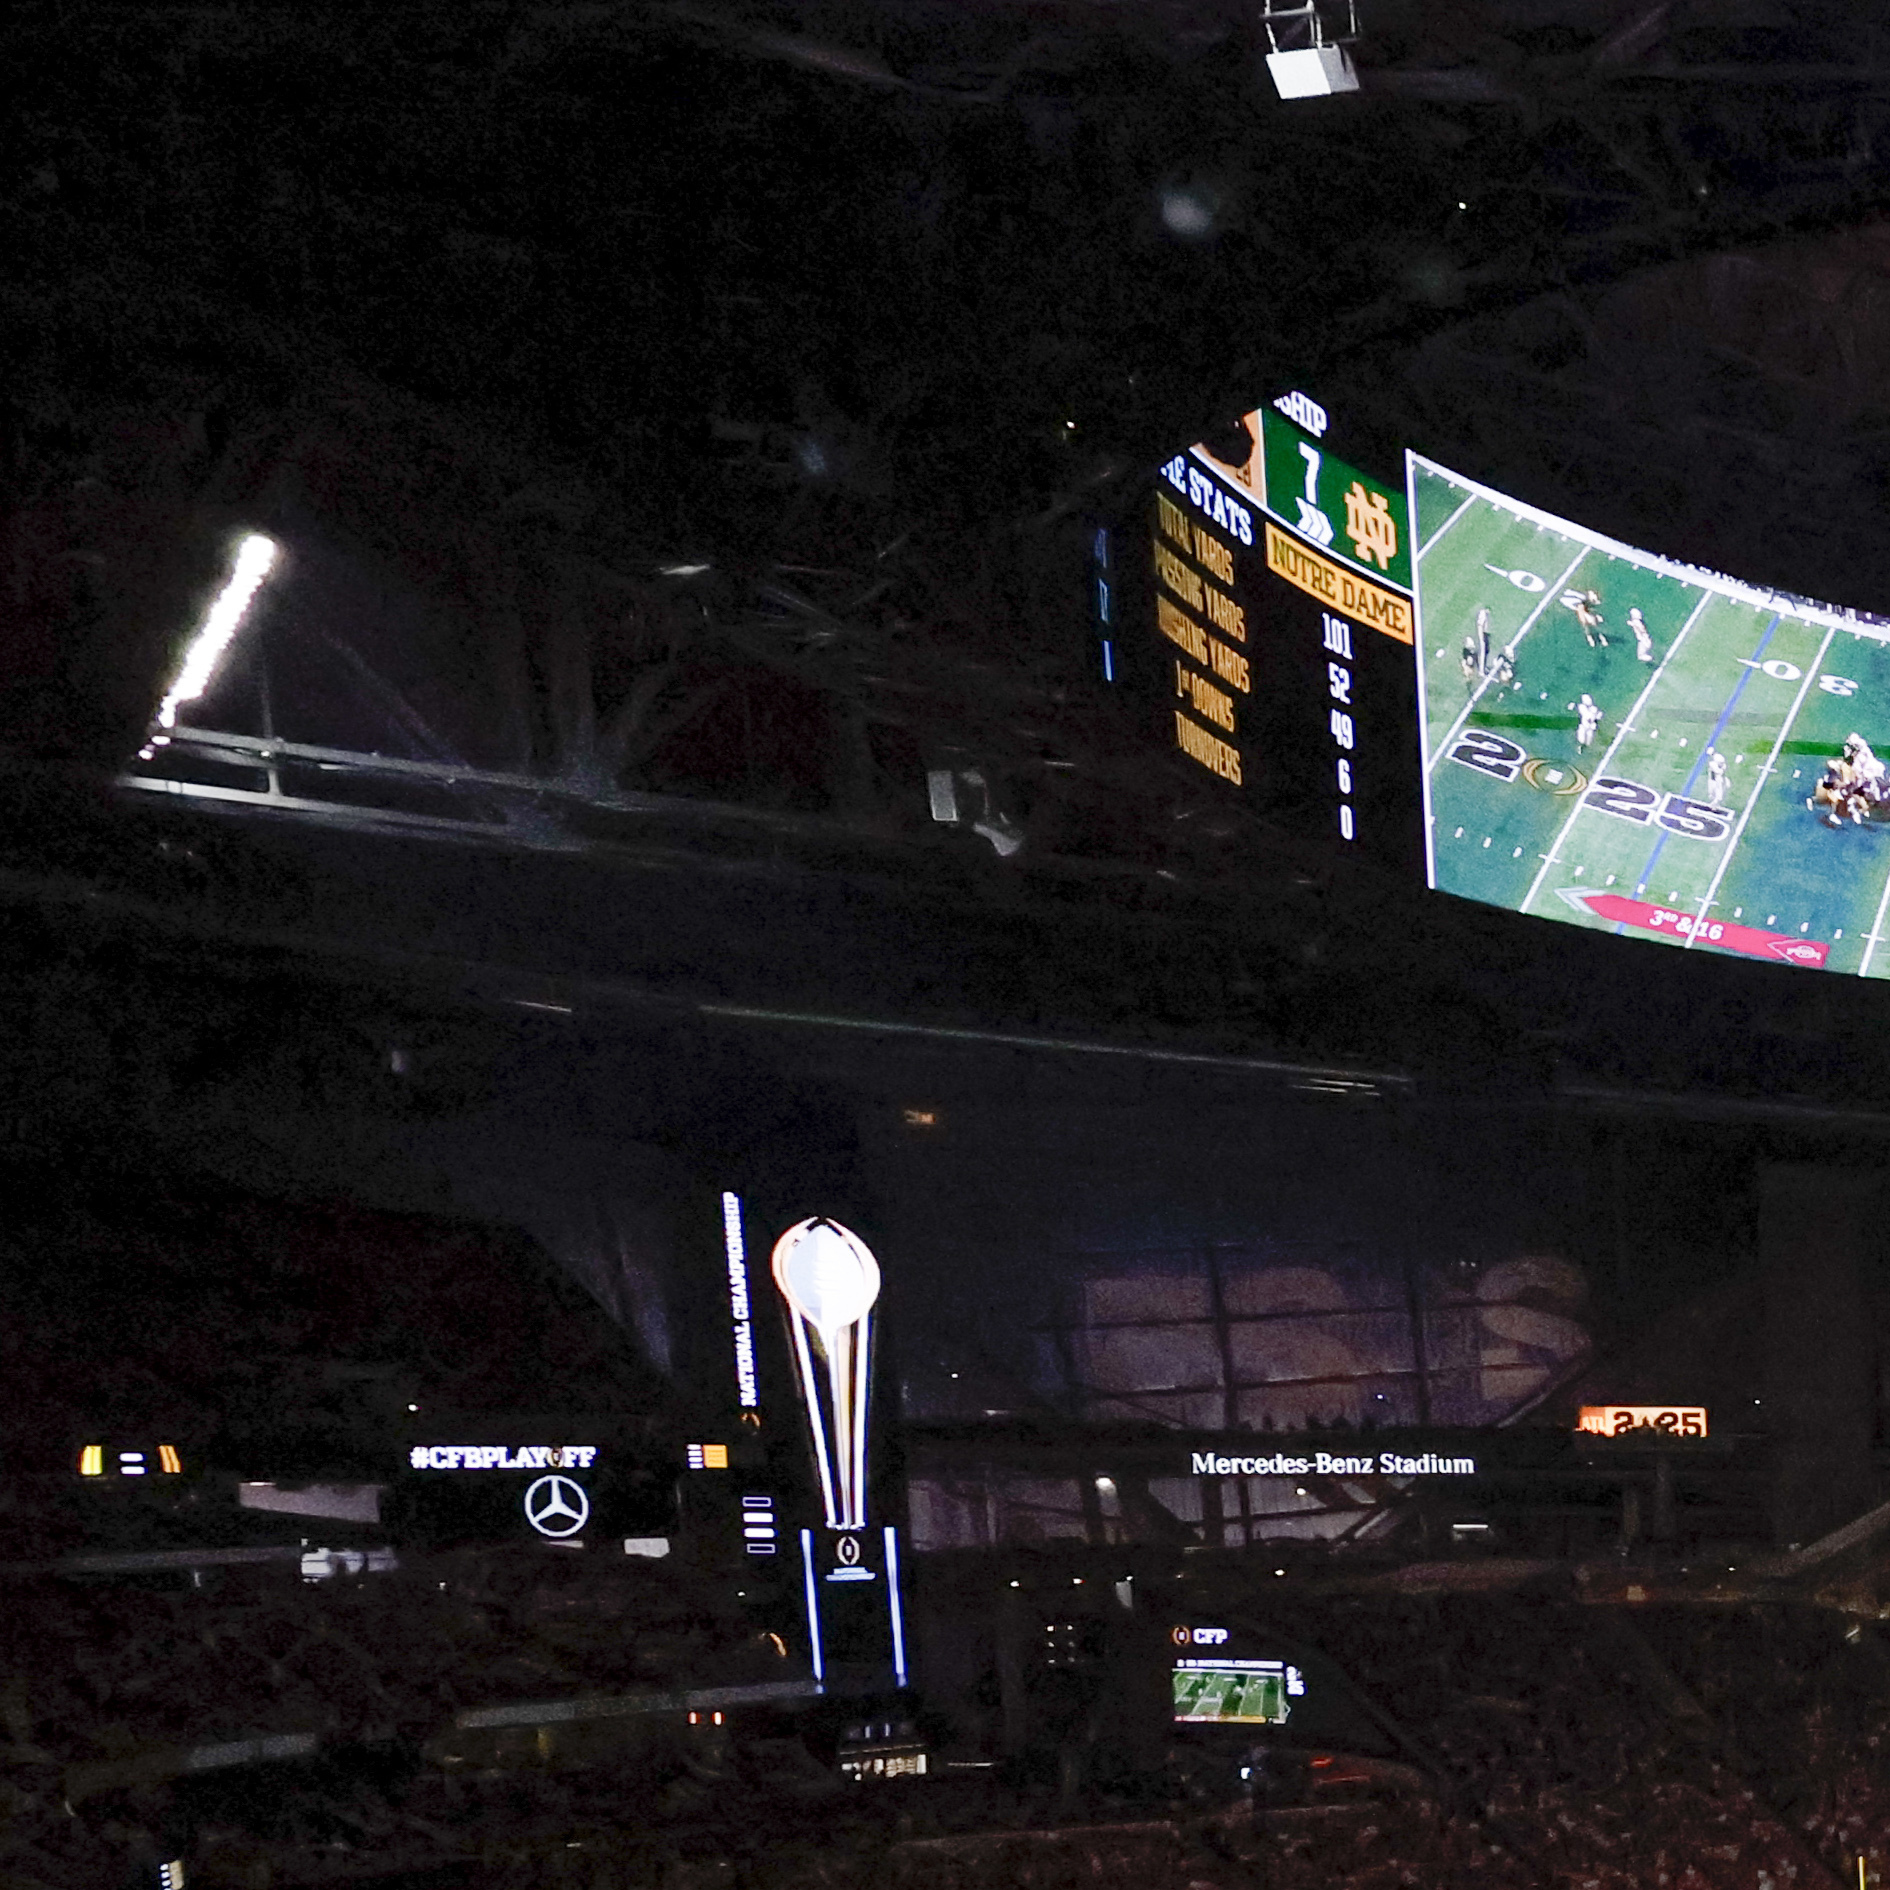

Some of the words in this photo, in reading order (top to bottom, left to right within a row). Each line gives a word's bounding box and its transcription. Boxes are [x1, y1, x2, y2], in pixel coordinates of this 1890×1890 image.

[1188, 466, 1253, 546] STATS
[1273, 532, 1336, 600] NOTRE
[1342, 573, 1406, 634] DAME
[1322, 612, 1353, 660] 101
[1328, 662, 1351, 704] 52
[1330, 709, 1354, 750] 49
[1338, 758, 1351, 794] 6
[722, 1191, 750, 1319] CHAMPIONSHIP
[733, 1321, 756, 1407] NATIONAL
[1192, 1453, 1373, 1475] Mercedes-Benz
[1380, 1453, 1475, 1475] Stadium
[1193, 1628, 1228, 1644] CFP
